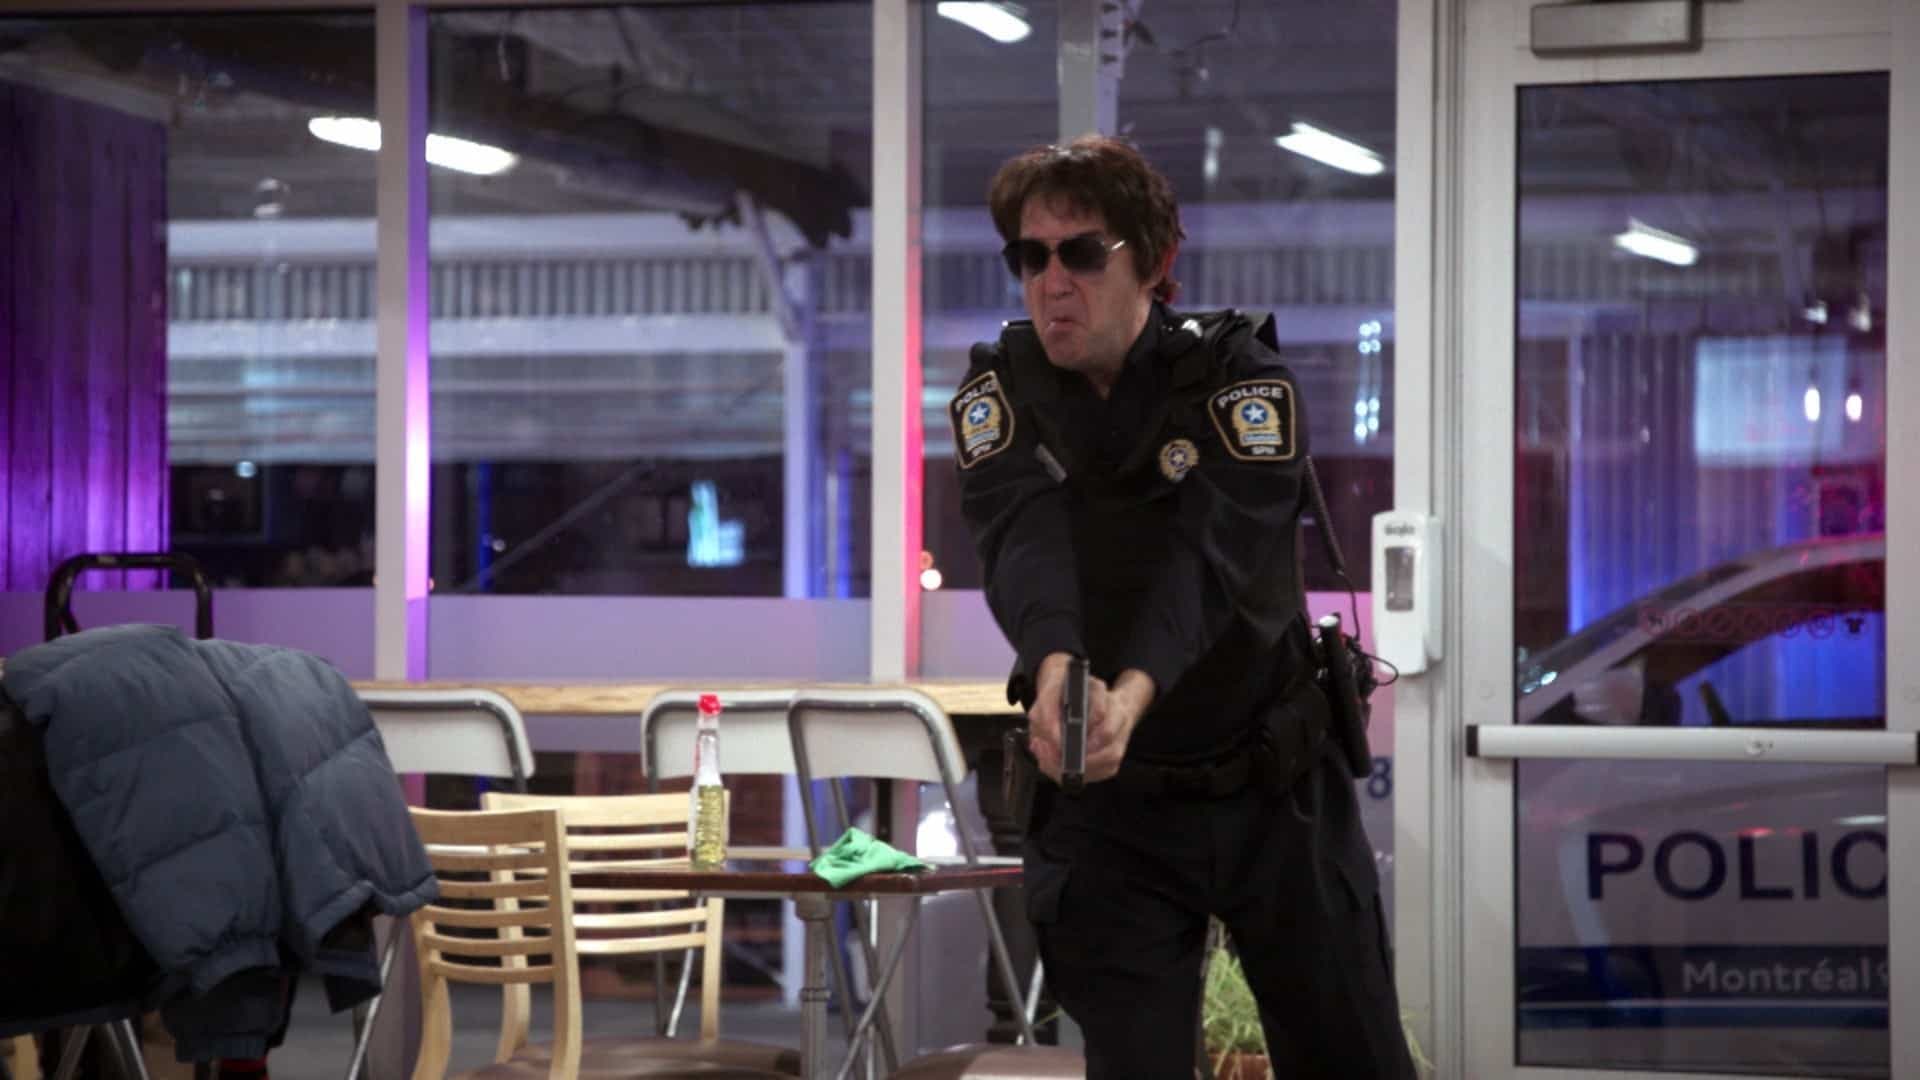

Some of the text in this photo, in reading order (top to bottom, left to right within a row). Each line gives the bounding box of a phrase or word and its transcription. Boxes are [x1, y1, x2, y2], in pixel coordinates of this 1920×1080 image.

[1217, 386, 1284, 409] POLICE
[1586, 830, 1888, 900] POLIC
[1682, 957, 1870, 992] Montréal
